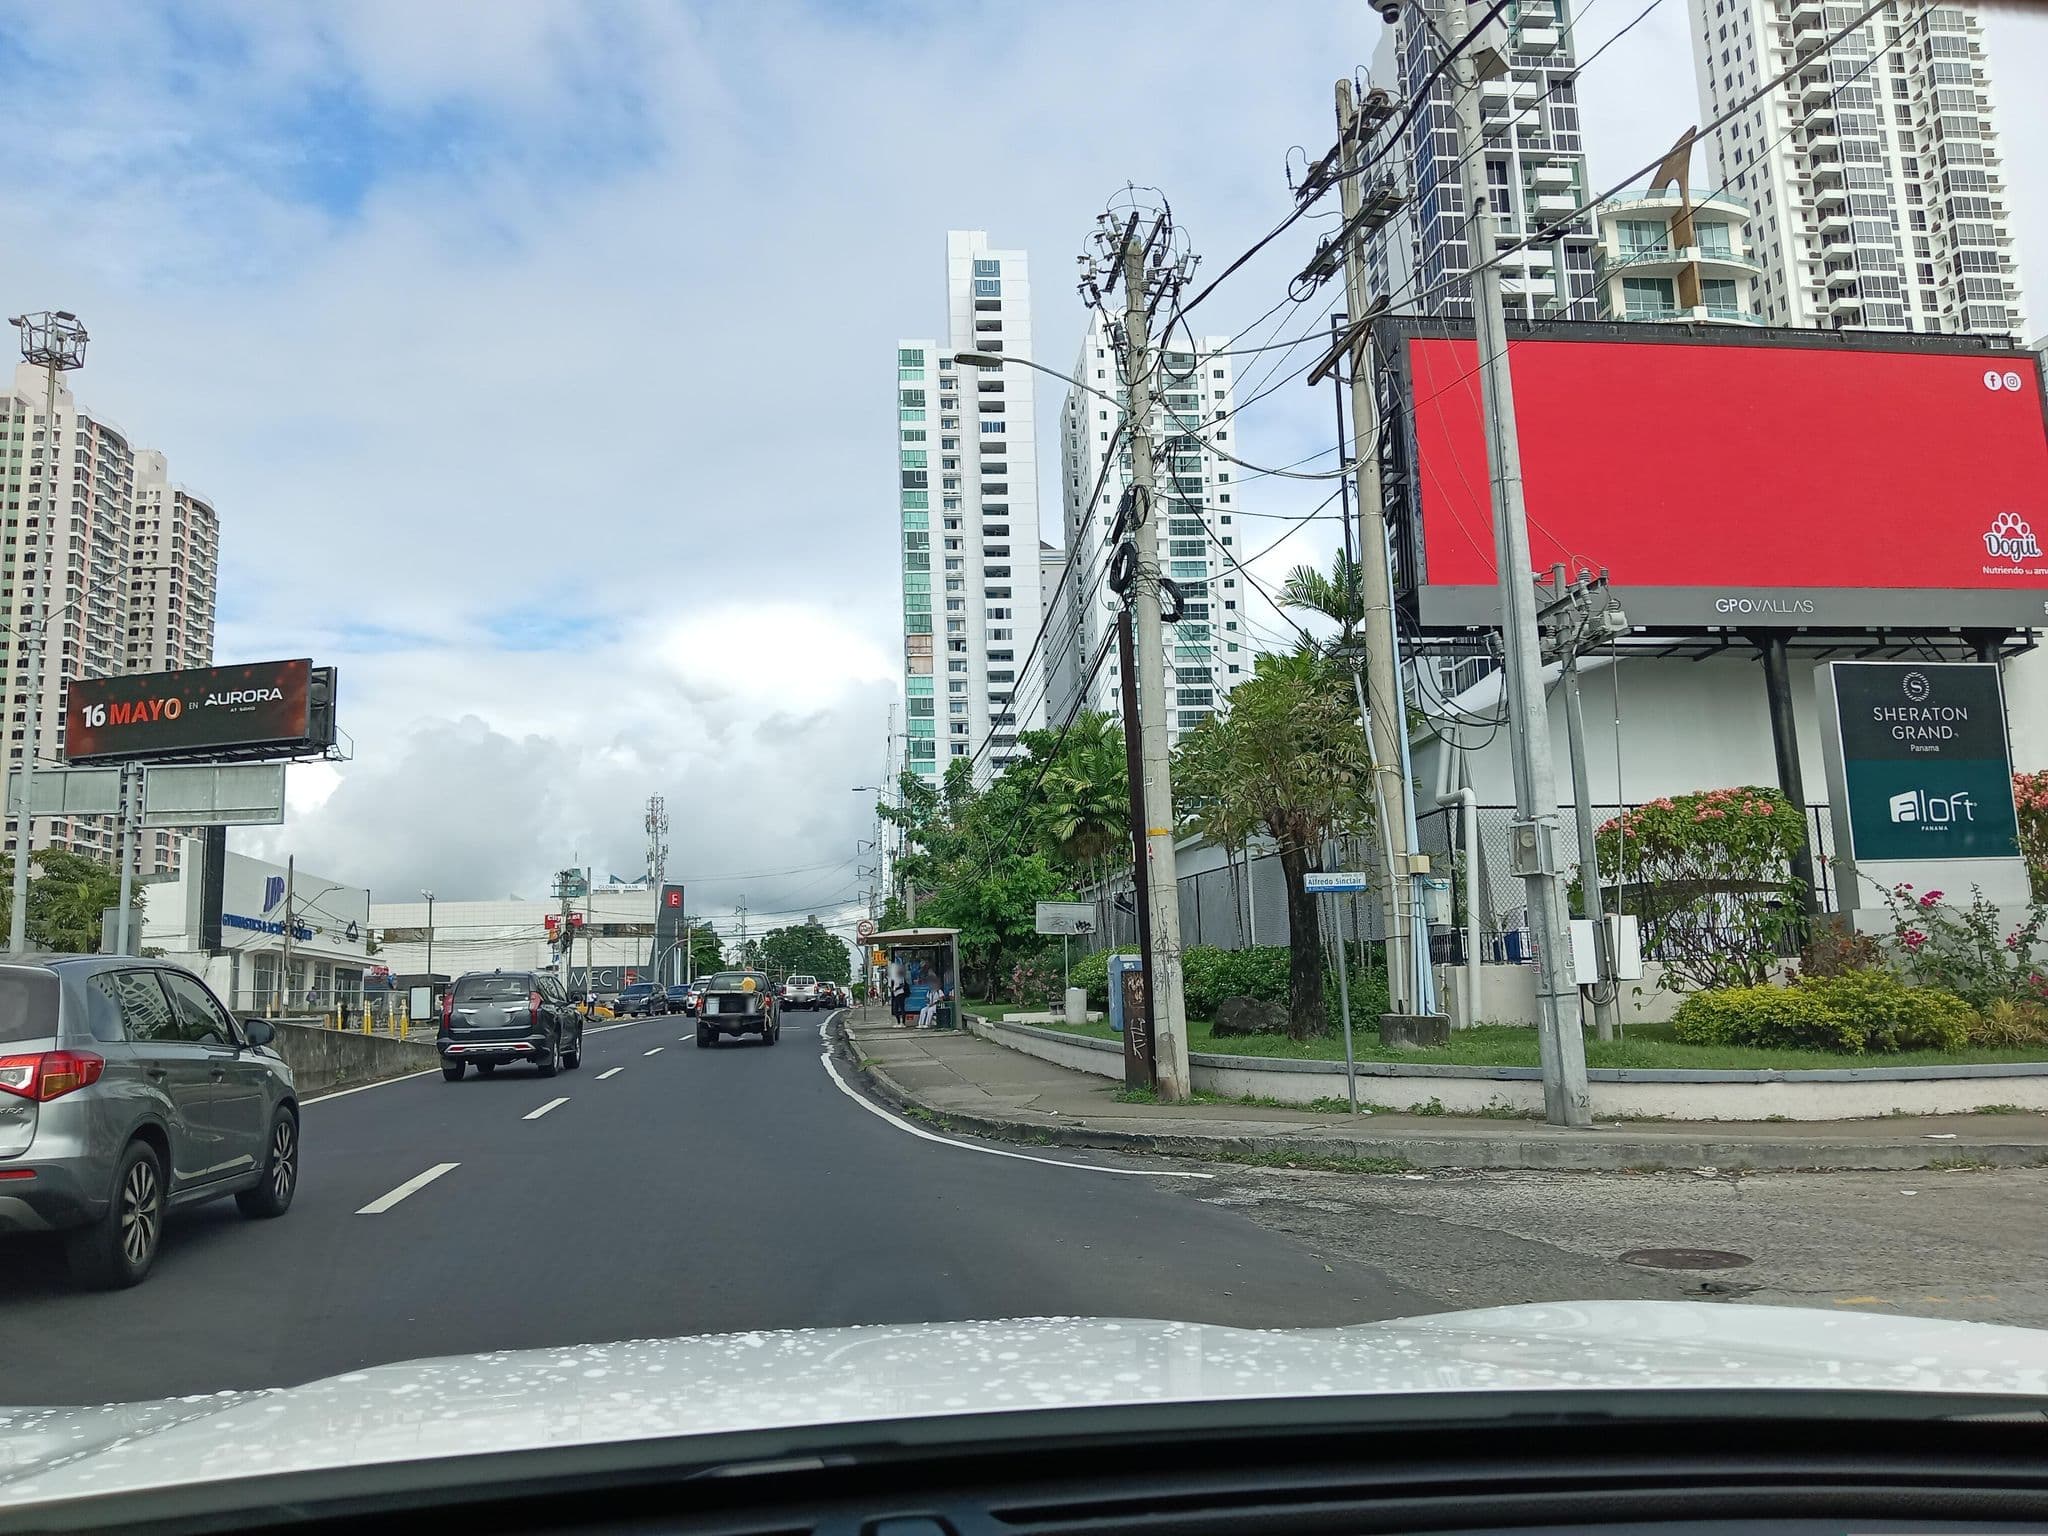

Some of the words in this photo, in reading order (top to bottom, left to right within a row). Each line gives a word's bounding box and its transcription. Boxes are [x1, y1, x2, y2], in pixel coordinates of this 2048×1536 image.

[1983, 566, 2025, 575] Nutriendo
[82, 703, 107, 728] 16
[109, 697, 182, 725] MAYO
[188, 702, 199, 710] EN
[204, 688, 283, 706] AURORA
[1873, 707, 1968, 721] SHERATON
[1892, 726, 1953, 740] GRAND
[1911, 744, 1939, 752] Panama
[1889, 789, 1974, 822] aloft
[1308, 878, 1334, 886] Alfredo
[1335, 877, 1361, 885] Sinclair
